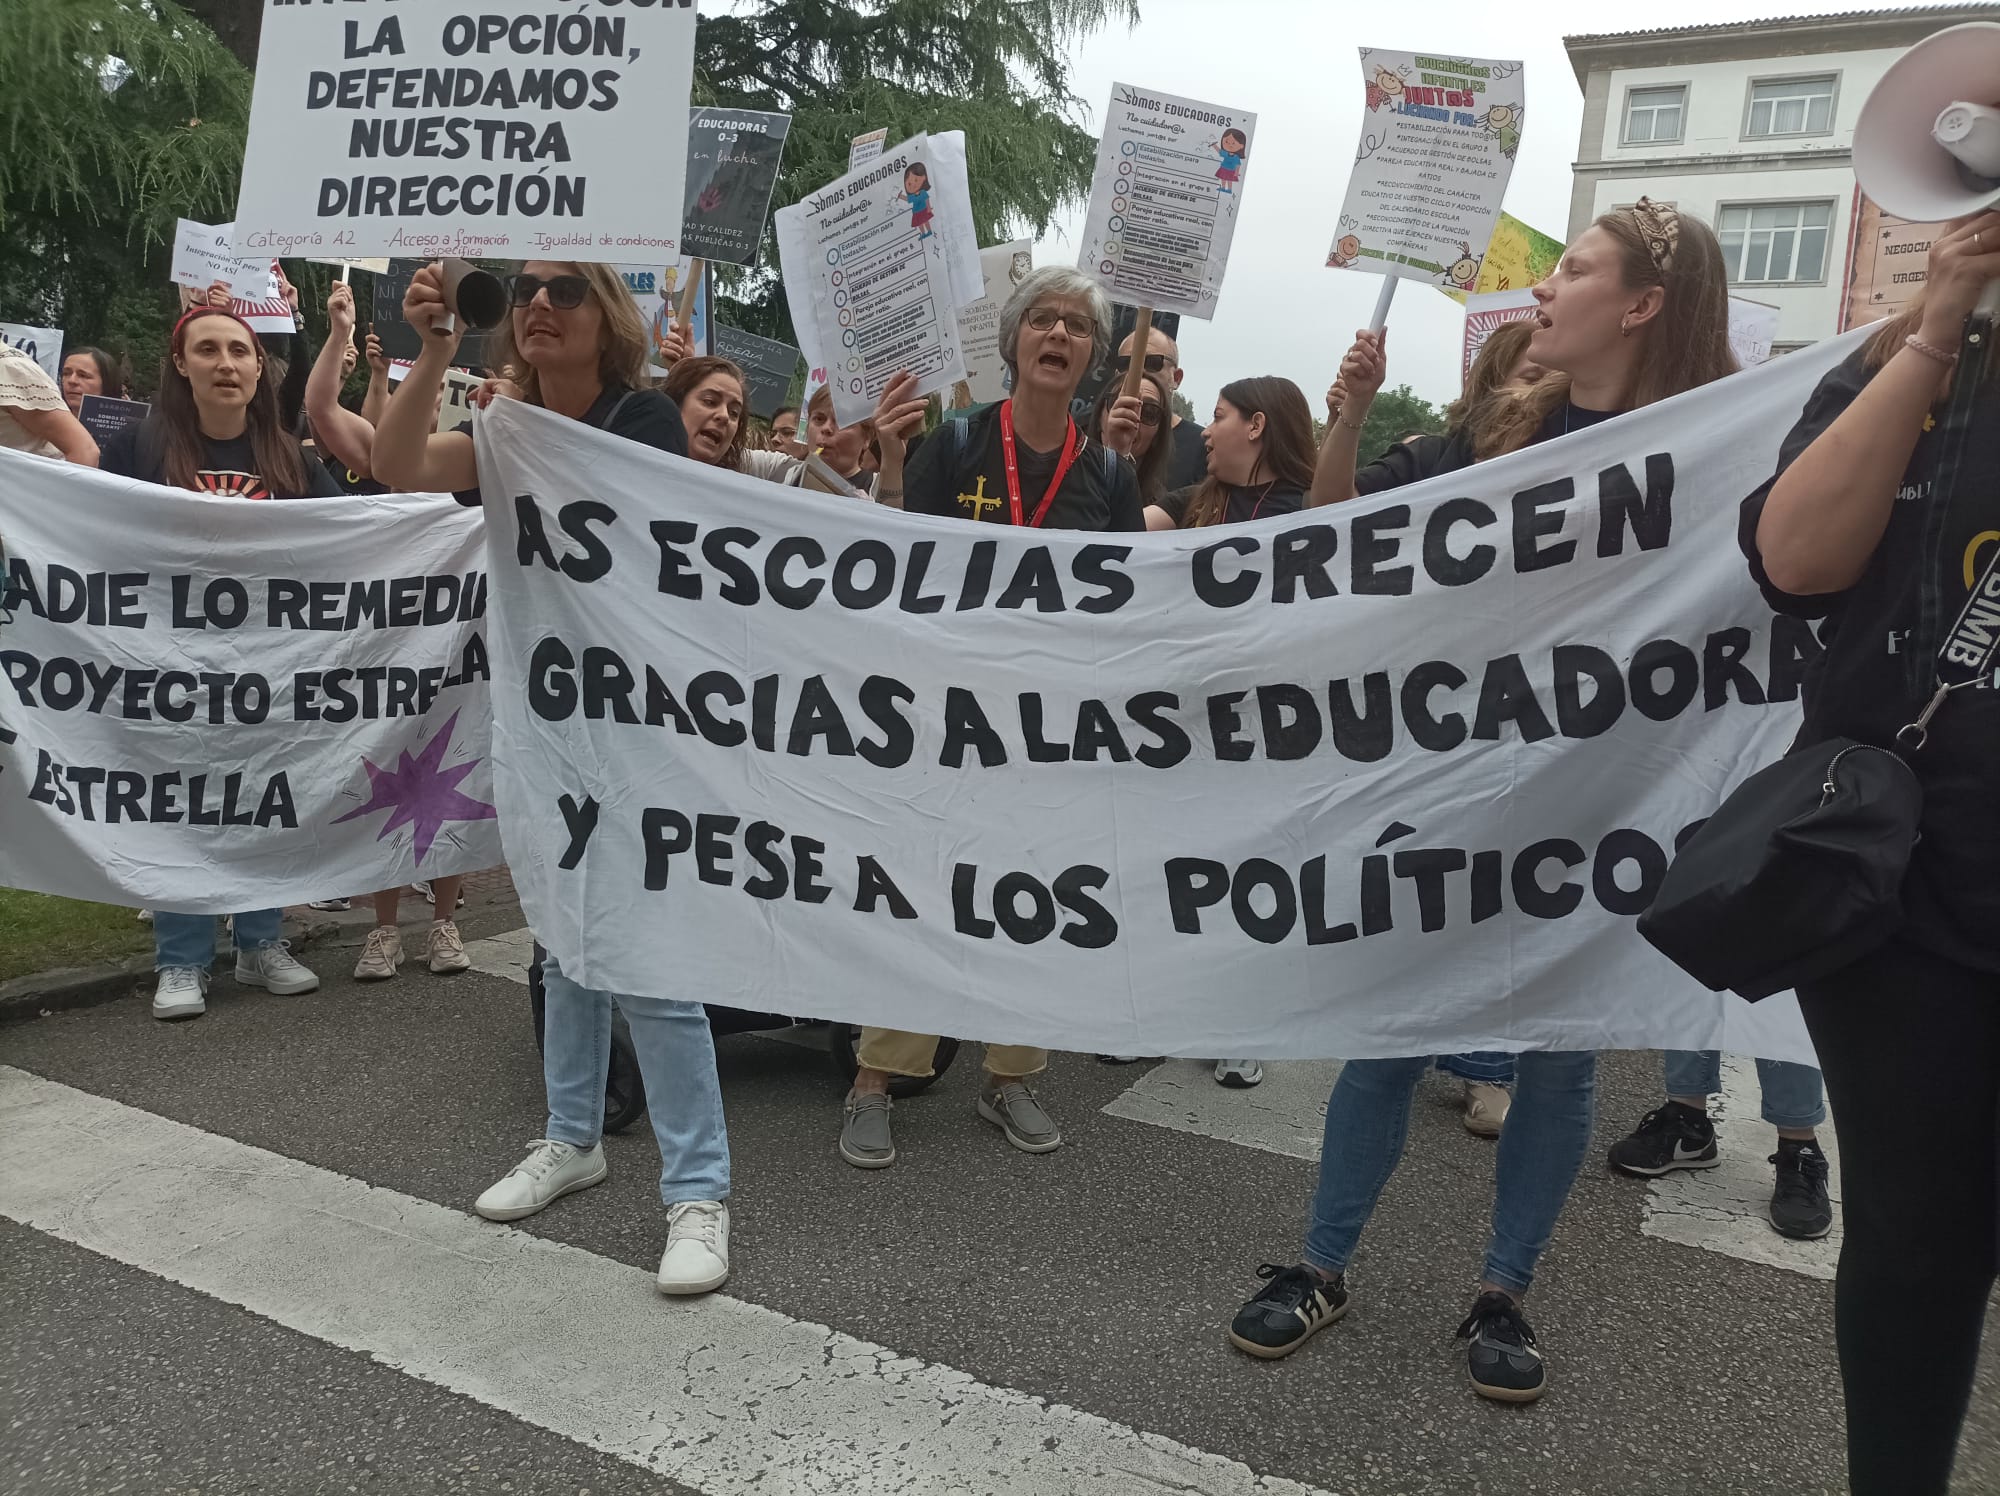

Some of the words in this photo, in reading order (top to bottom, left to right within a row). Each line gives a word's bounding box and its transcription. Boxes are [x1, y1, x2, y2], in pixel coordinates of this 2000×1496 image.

[345, 15, 405, 59] LA
[442, 4, 640, 64] OPCIÓN,
[306, 67, 621, 111] DEFENDAMOS
[1405, 86, 1475, 107] JUNT@S
[698, 119, 768, 134] EDUCADORAS
[1125, 93, 1161, 111] SOMOS
[1164, 102, 1232, 128] EDUCADOR@S
[1125, 111, 1139, 122] No
[349, 116, 571, 162] NUESTRA
[718, 132, 738, 143] 0-3
[317, 166, 585, 217] DIRECCIÓN
[814, 188, 845, 214] SOMOS
[848, 155, 908, 197] EDUCADOR@S
[333, 230, 357, 246] A2
[443, 235, 451, 246] a
[456, 228, 511, 248] formación
[599, 232, 613, 246] de
[616, 234, 675, 249] condiciones
[819, 215, 832, 230] No
[185, 245, 231, 263] Integración
[207, 261, 220, 270] NO
[1884, 241, 1932, 256] NEGOCIA
[517, 495, 617, 583] AS
[650, 520, 1135, 614] ESCOLIAS
[1191, 452, 1675, 608] CRECEN
[171, 575, 249, 630] LO
[528, 637, 915, 768] GRACIAS
[939, 686, 1005, 768] A
[1018, 691, 1192, 768] LAS
[1206, 614, 1822, 763] EDUCADORA
[28, 748, 298, 829] ESTRELLA
[558, 793, 600, 870] Y
[641, 807, 833, 905] PESE
[853, 854, 918, 920] A
[952, 862, 1119, 949] LOS
[1164, 819, 1700, 946] POLÍTICO
